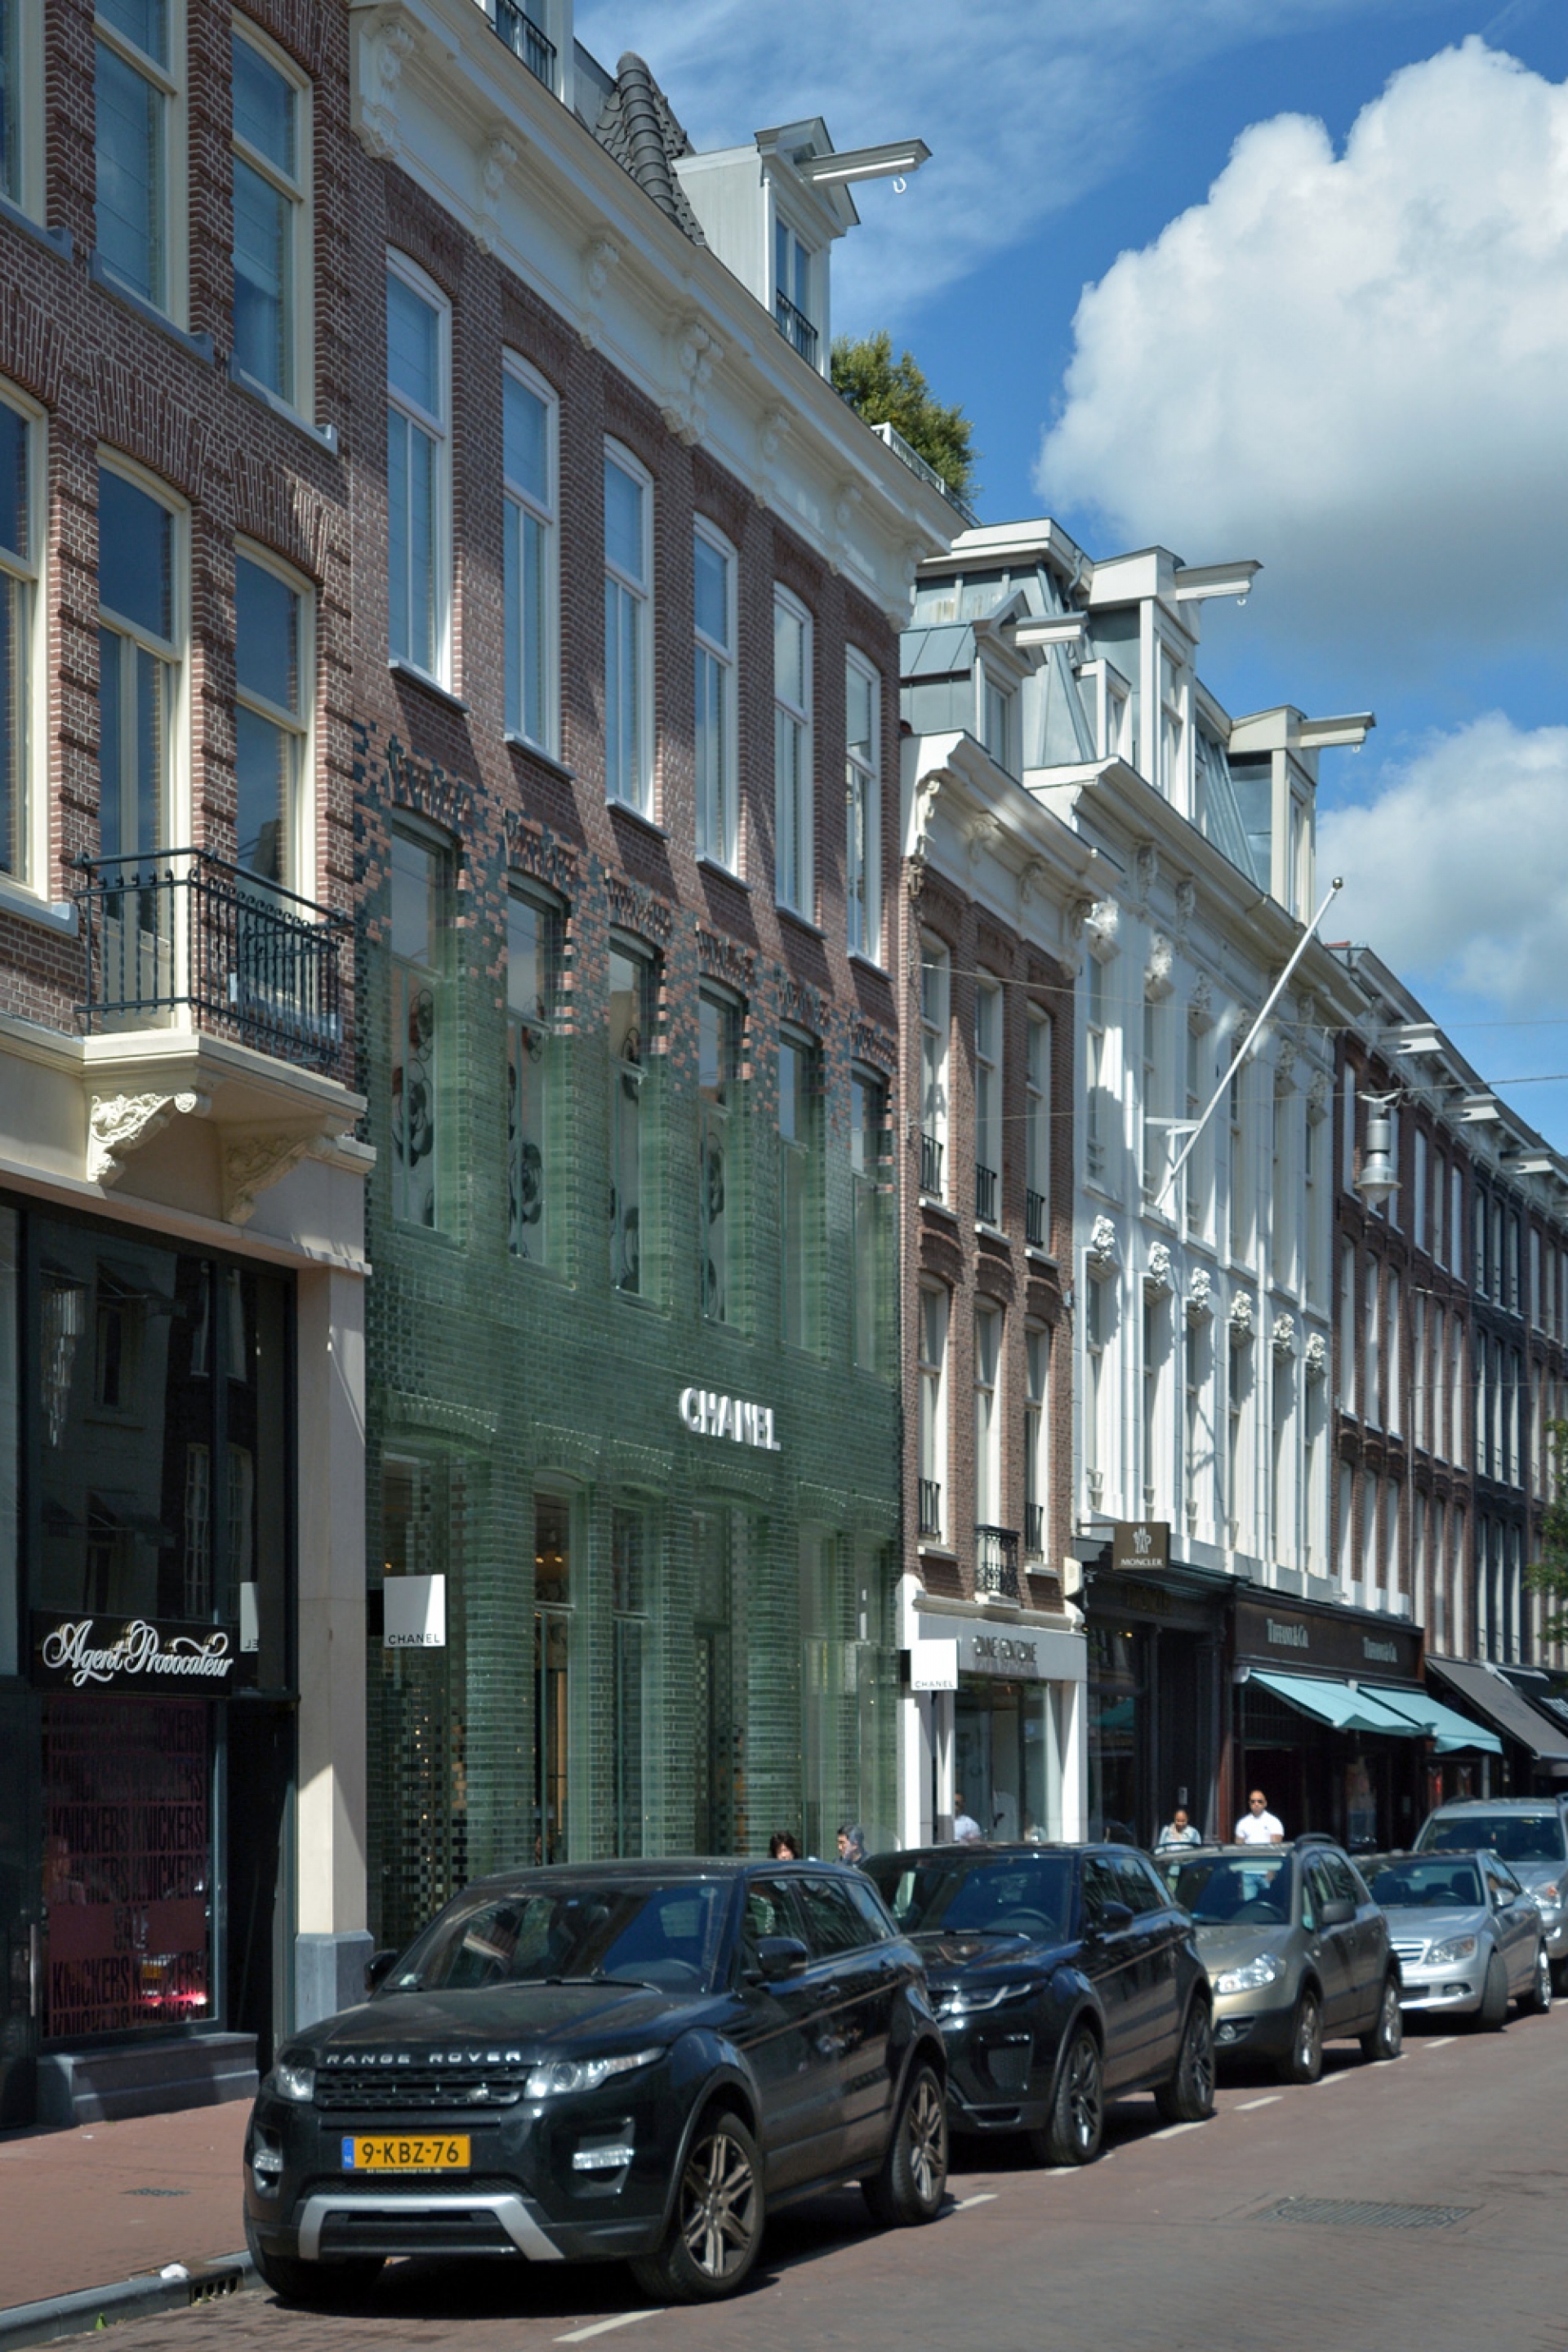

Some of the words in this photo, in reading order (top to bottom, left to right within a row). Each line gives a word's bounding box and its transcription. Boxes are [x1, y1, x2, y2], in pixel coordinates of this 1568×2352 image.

[679, 1387, 782, 1451] CHANEL
[1120, 1557, 1163, 1566] MONCLER
[388, 1633, 441, 1645] CHANEL
[42, 1619, 128, 1687] Agent
[124, 1619, 234, 1678] Provocateur
[915, 1680, 955, 1688] CHANEL
[326, 2054, 411, 2065] RANGE
[429, 2051, 522, 2064] ROVER
[362, 2141, 460, 2164] 9-KBZ-76
